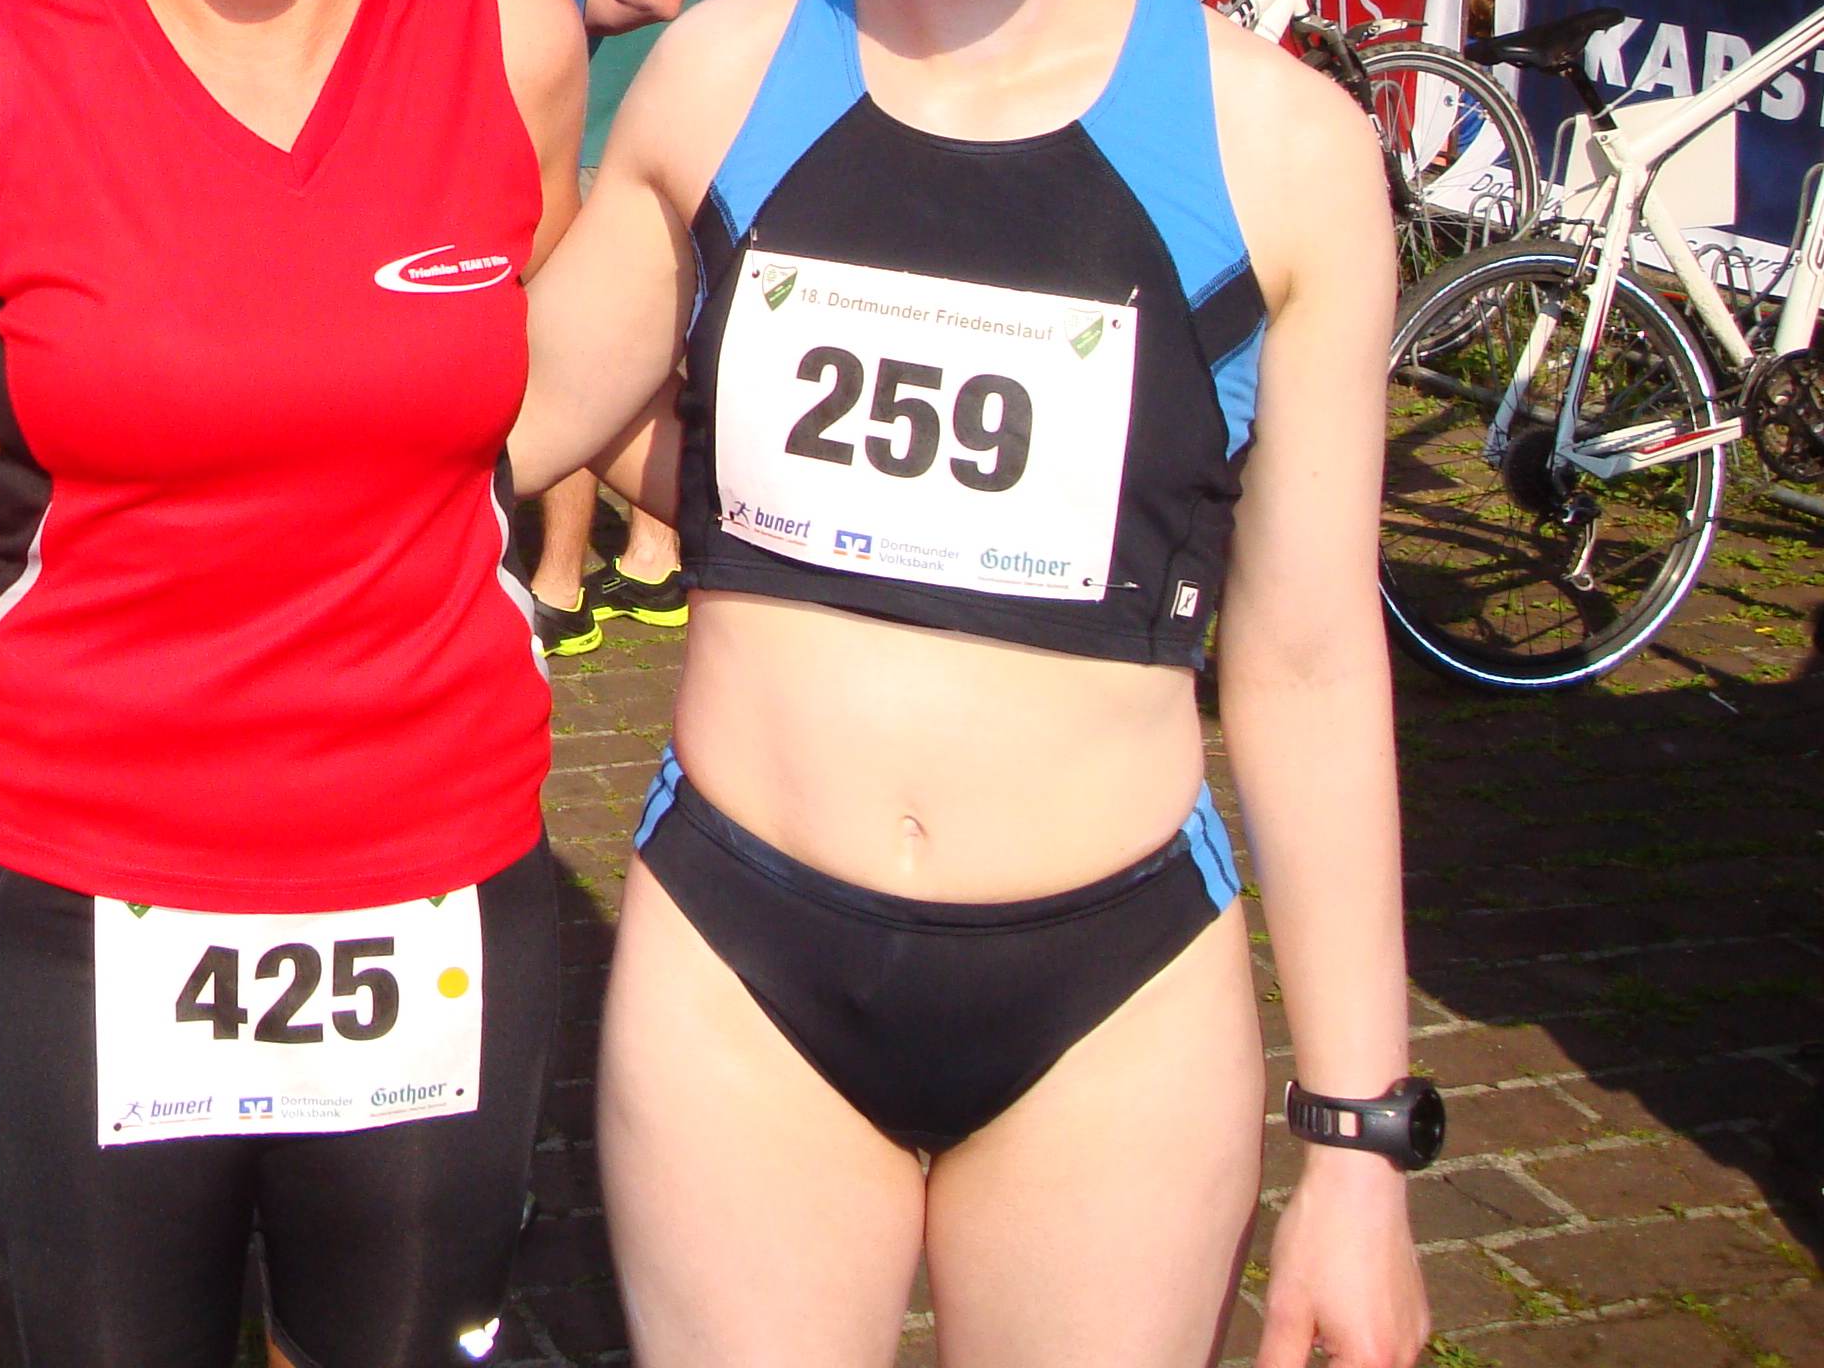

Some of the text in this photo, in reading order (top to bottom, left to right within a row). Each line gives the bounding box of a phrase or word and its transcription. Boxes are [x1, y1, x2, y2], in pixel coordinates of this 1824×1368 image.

[799, 288, 822, 306] 18.
[827, 292, 929, 323] Dortmunder
[935, 310, 1053, 342] Friedenslauf
[784, 346, 1033, 493] 259
[754, 507, 811, 539] bunert
[878, 551, 945, 572] Volksbank
[879, 537, 960, 561] Dortmunder
[979, 548, 1072, 579] Gothaer
[175, 936, 400, 1044] 425
[150, 1096, 213, 1118] bunert
[370, 1082, 447, 1107] Gothaer
